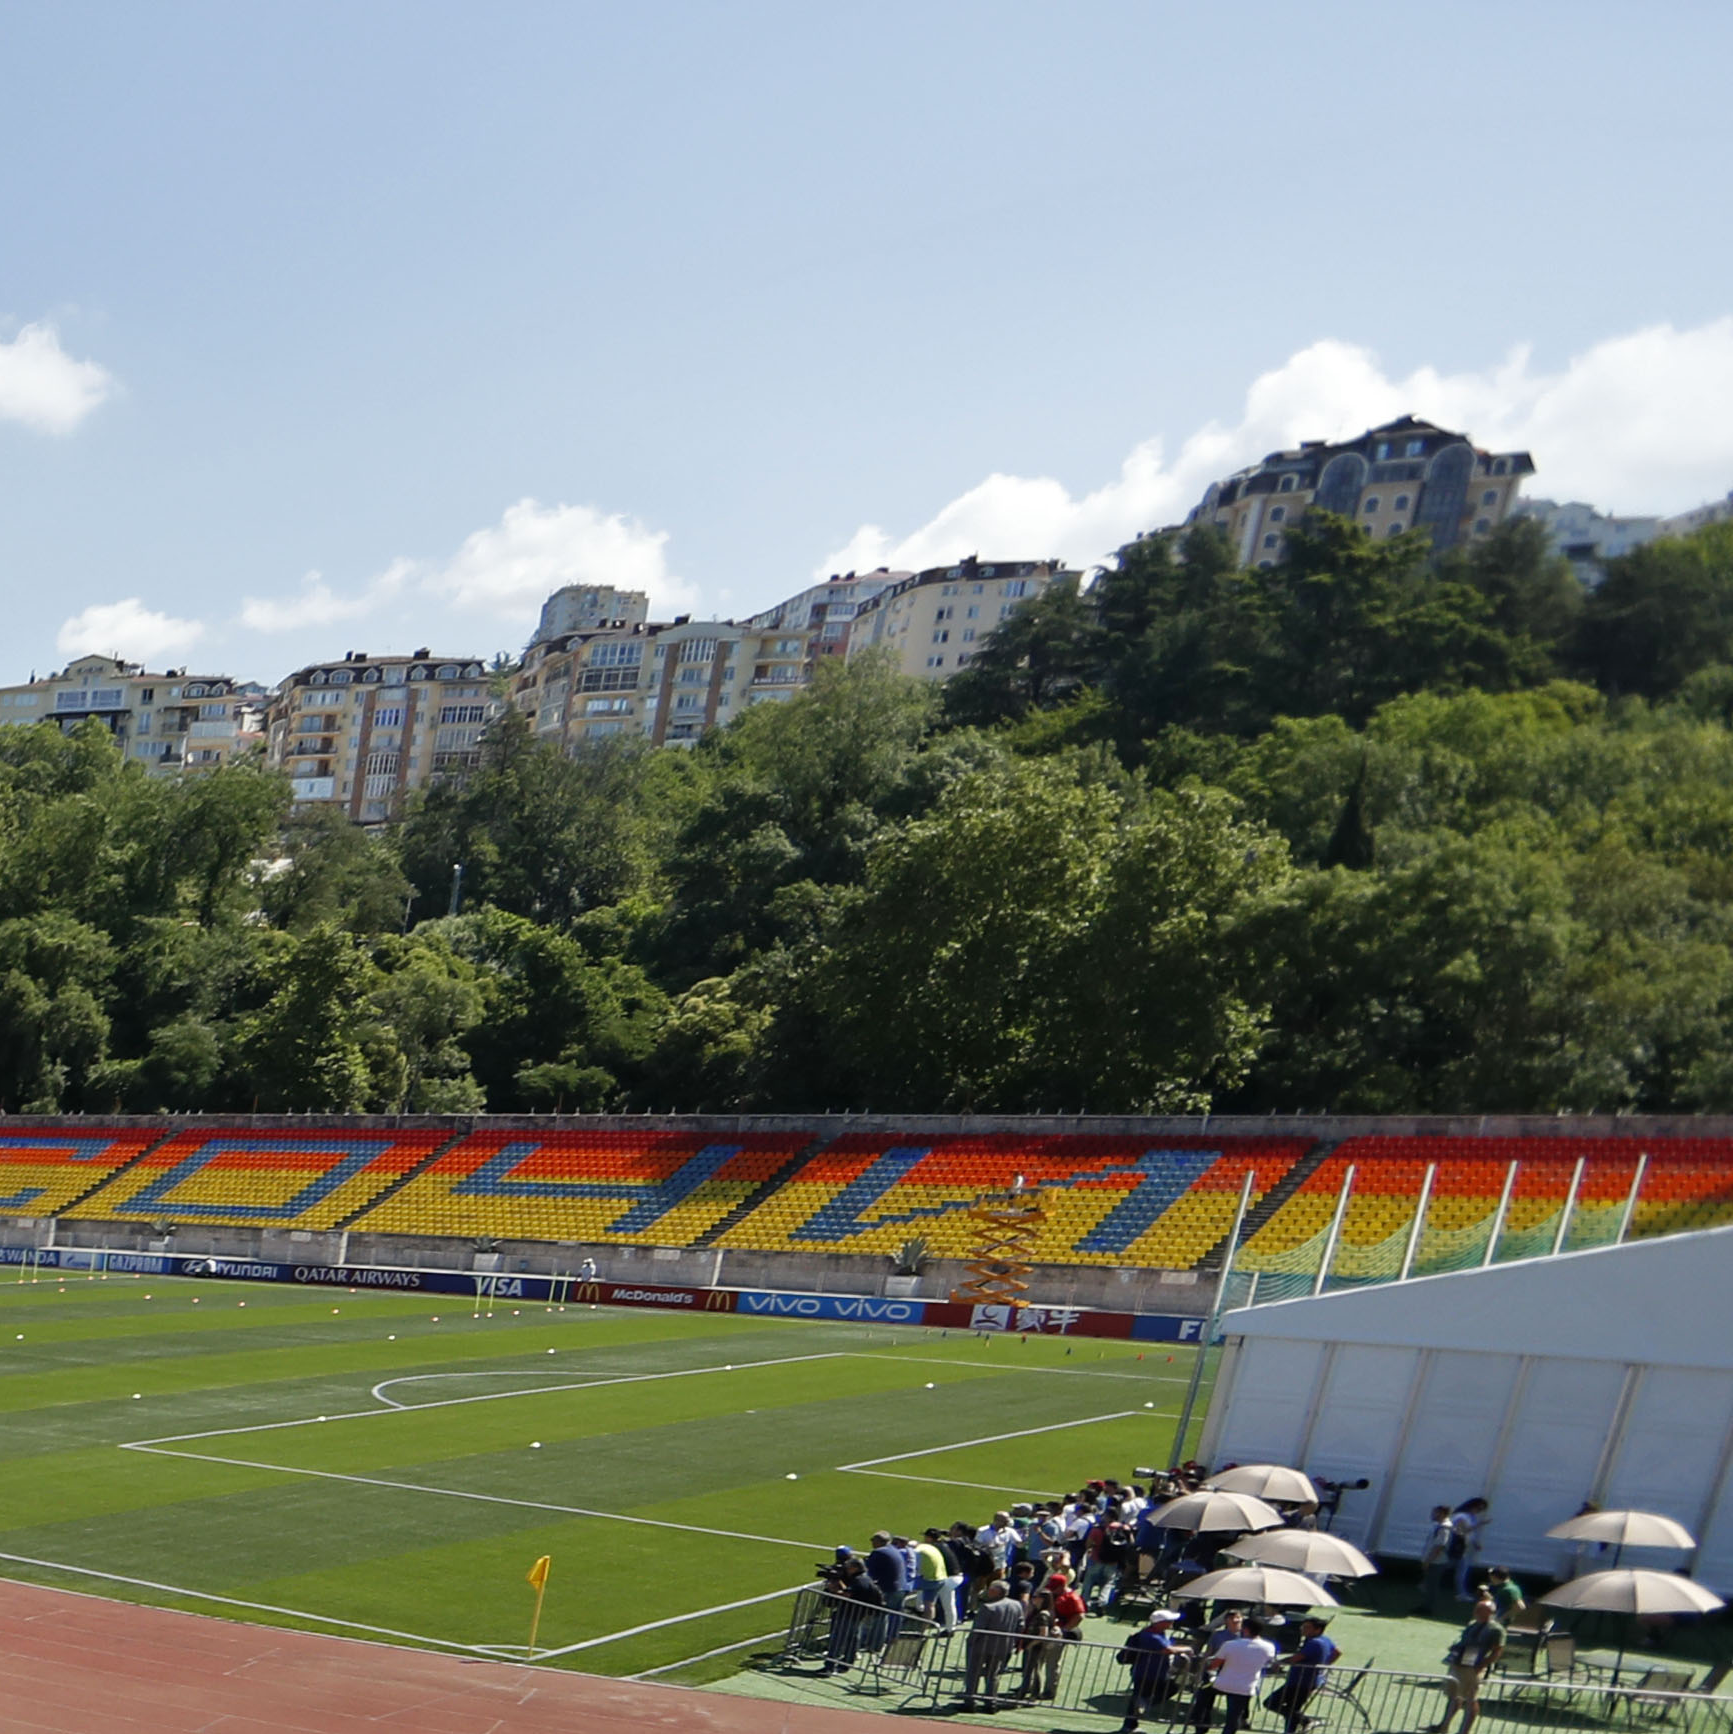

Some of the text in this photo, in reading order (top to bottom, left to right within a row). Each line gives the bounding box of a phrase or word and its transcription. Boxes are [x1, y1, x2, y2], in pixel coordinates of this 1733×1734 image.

[108, 1254, 163, 1273] GAZPROM
[294, 1266, 421, 1288] QATAR AIRWAYS
[472, 1276, 522, 1297] VISA
[612, 1287, 694, 1305] McDonald's
[747, 1294, 912, 1320] vivo vivo
